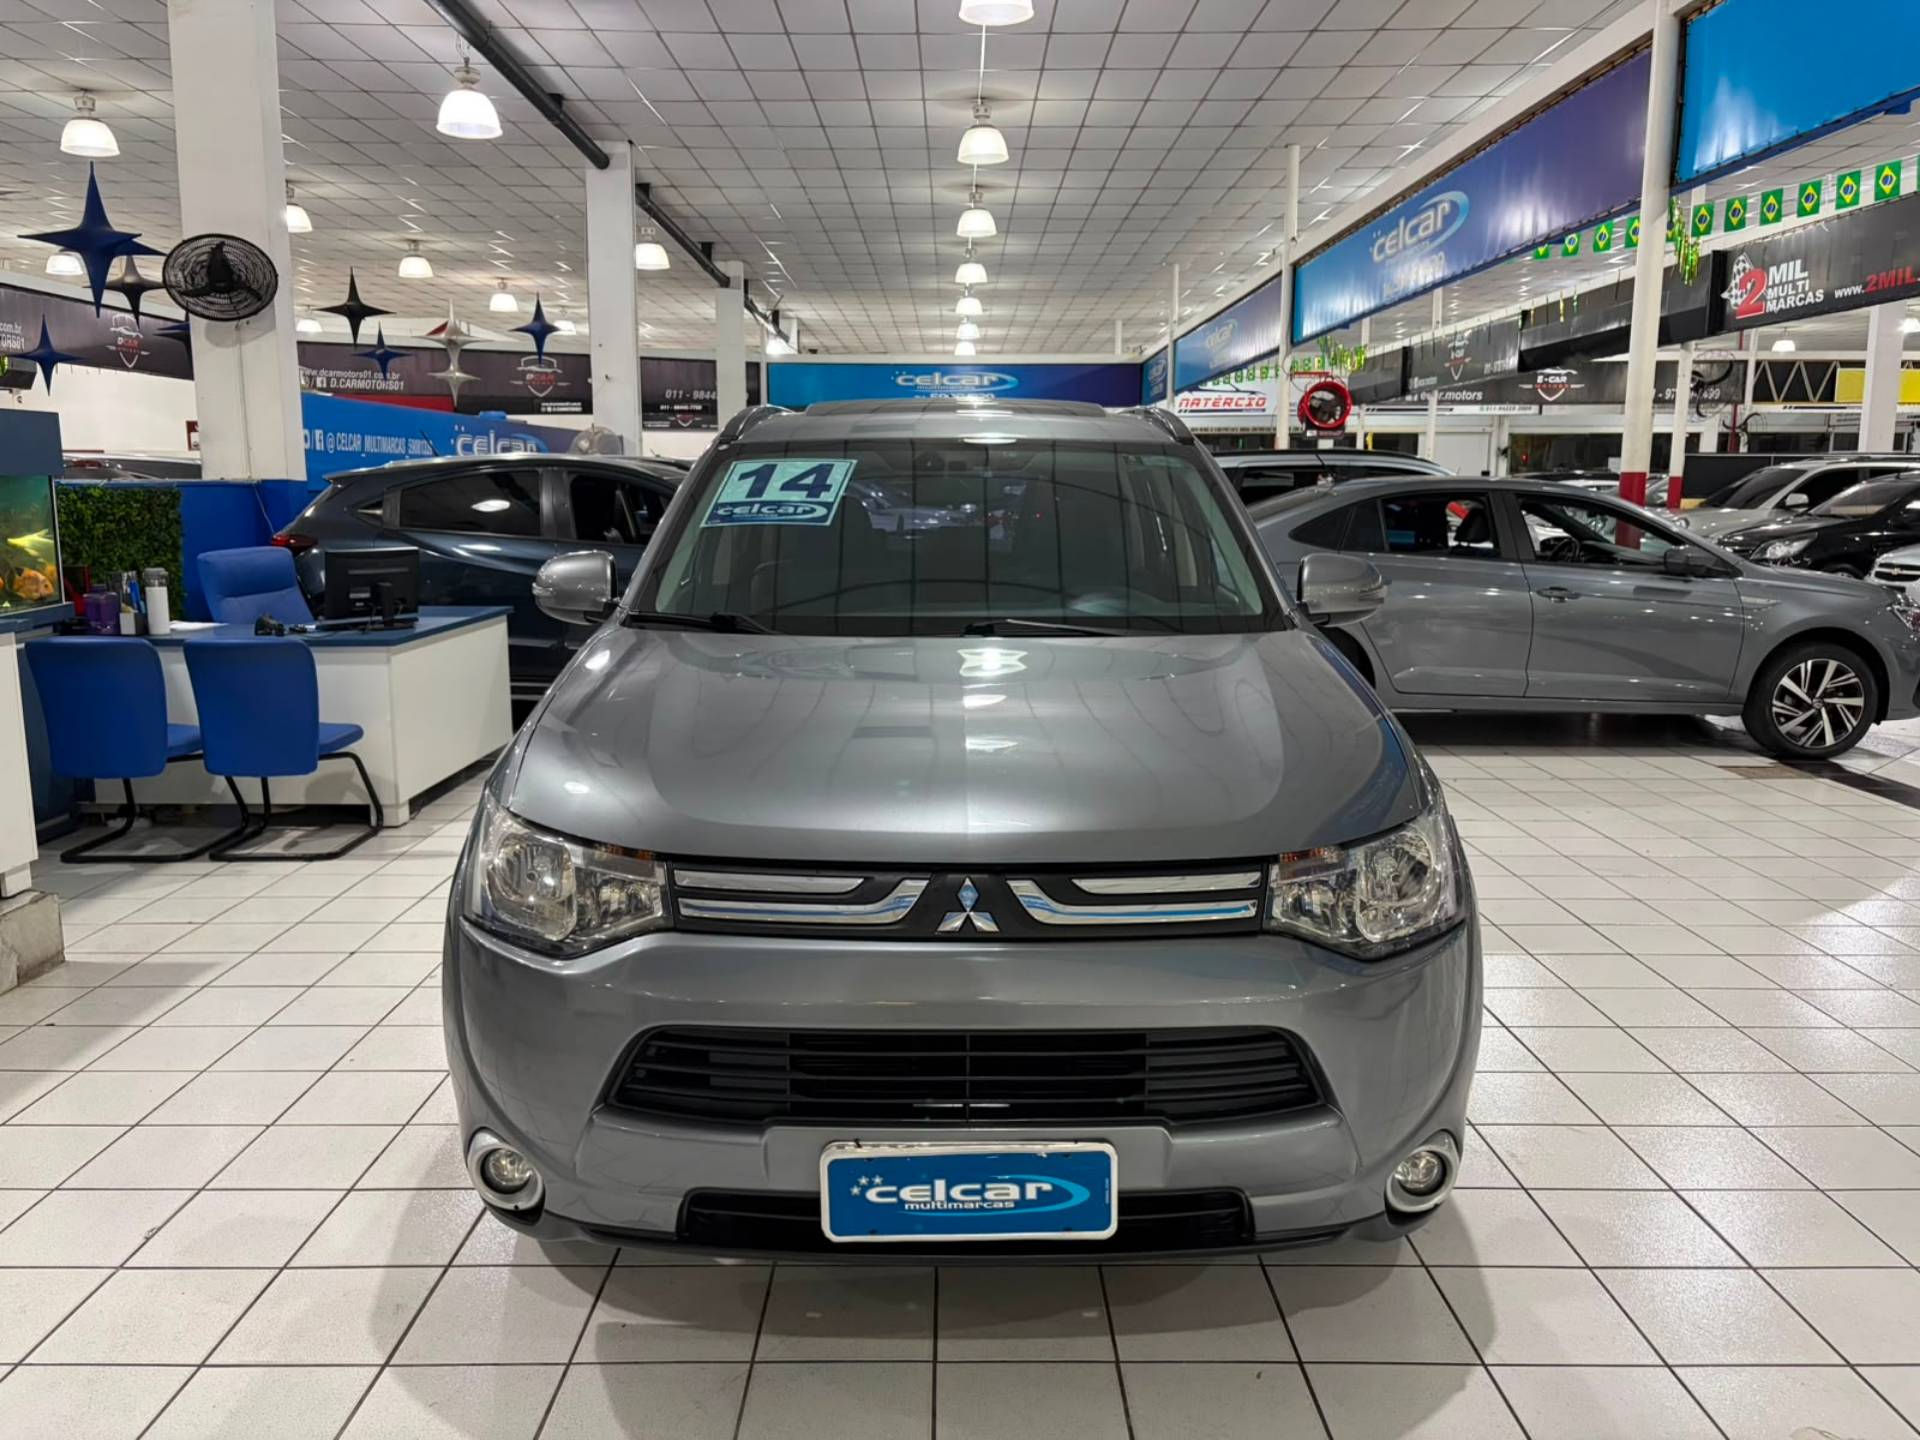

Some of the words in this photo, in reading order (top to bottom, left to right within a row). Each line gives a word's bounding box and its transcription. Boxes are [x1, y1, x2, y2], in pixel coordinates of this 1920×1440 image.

[1373, 202, 1451, 263] celcar
[1769, 259, 1809, 286] MIL
[1736, 266, 1768, 319] 2
[1765, 289, 1825, 313] MARCAS
[1766, 279, 1811, 302] MULTI
[896, 372, 998, 386] celcar
[738, 464, 835, 499] 14
[717, 503, 809, 516] celcar
[865, 1179, 1052, 1204] celcar
[904, 1199, 1015, 1211] multimarcas
